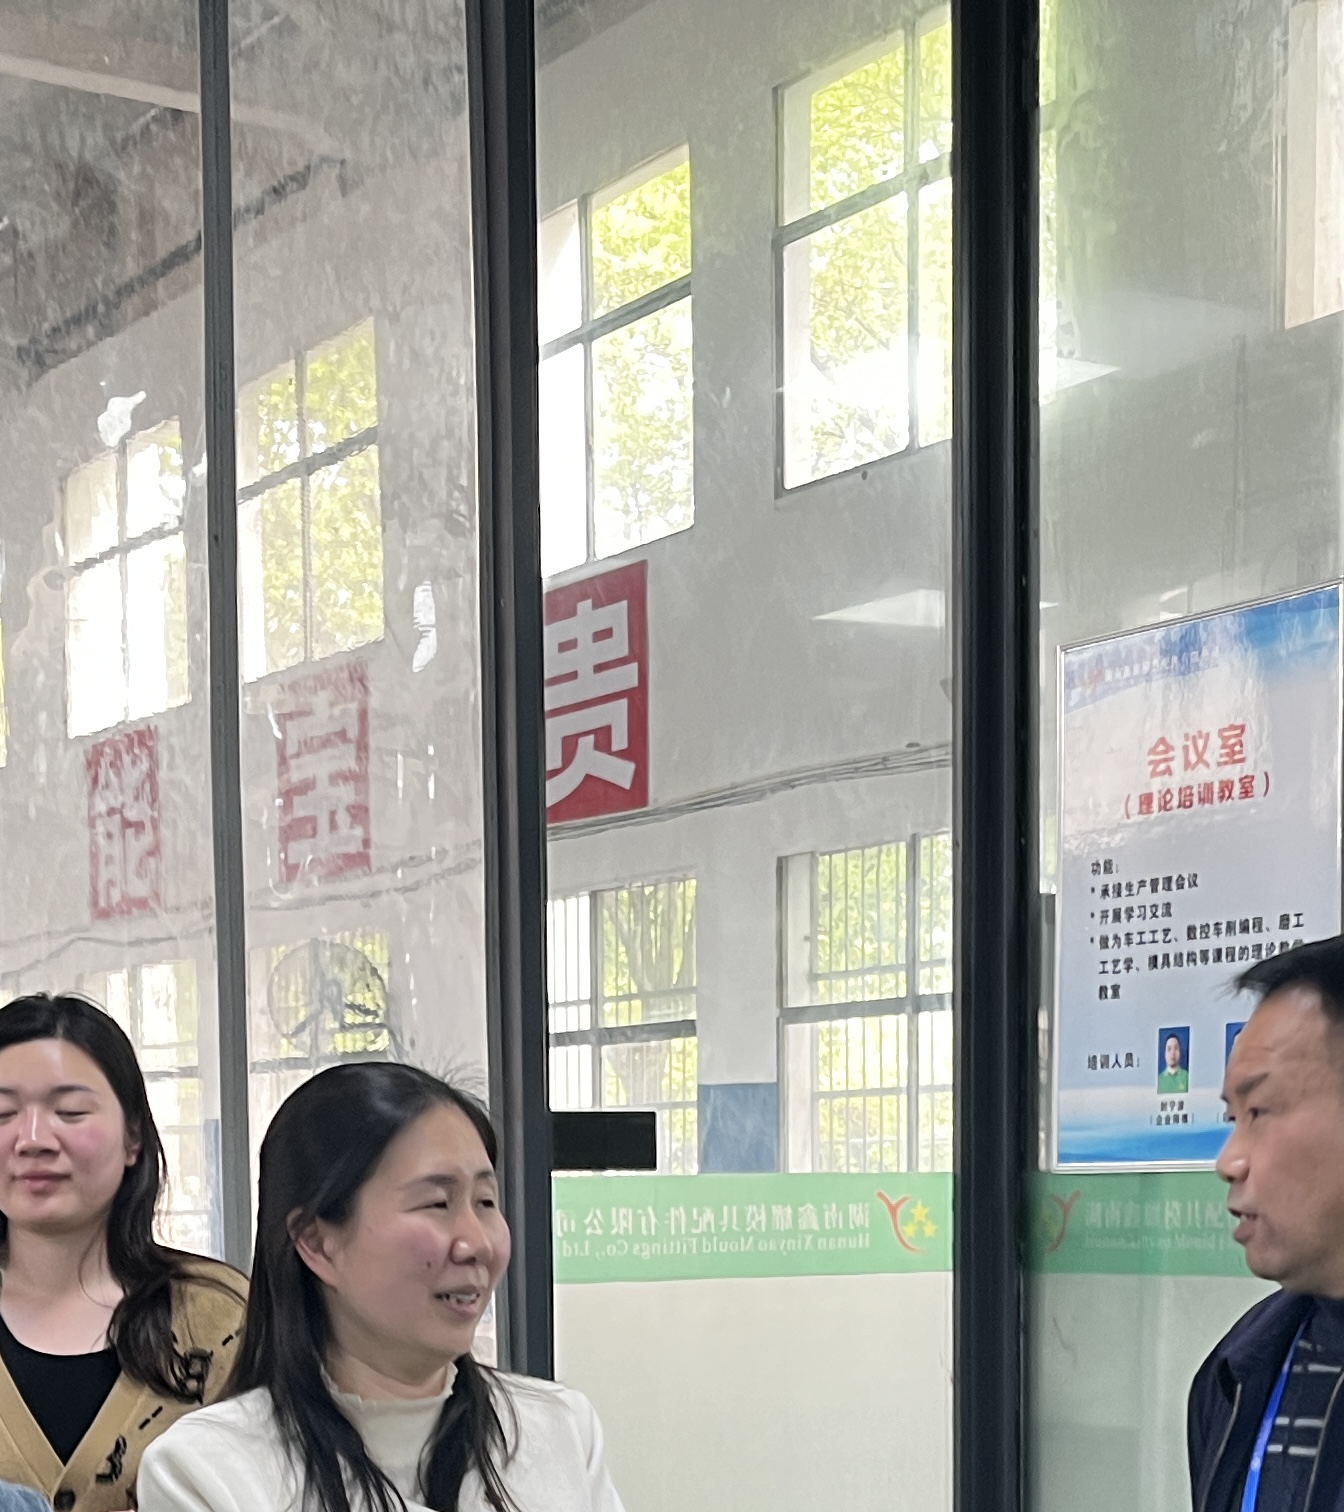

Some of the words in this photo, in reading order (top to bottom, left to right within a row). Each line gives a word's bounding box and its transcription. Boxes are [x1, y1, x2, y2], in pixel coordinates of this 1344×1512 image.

[1146, 723, 1247, 779] 会议室
[1124, 771, 1271, 820] （理论培训教室）
